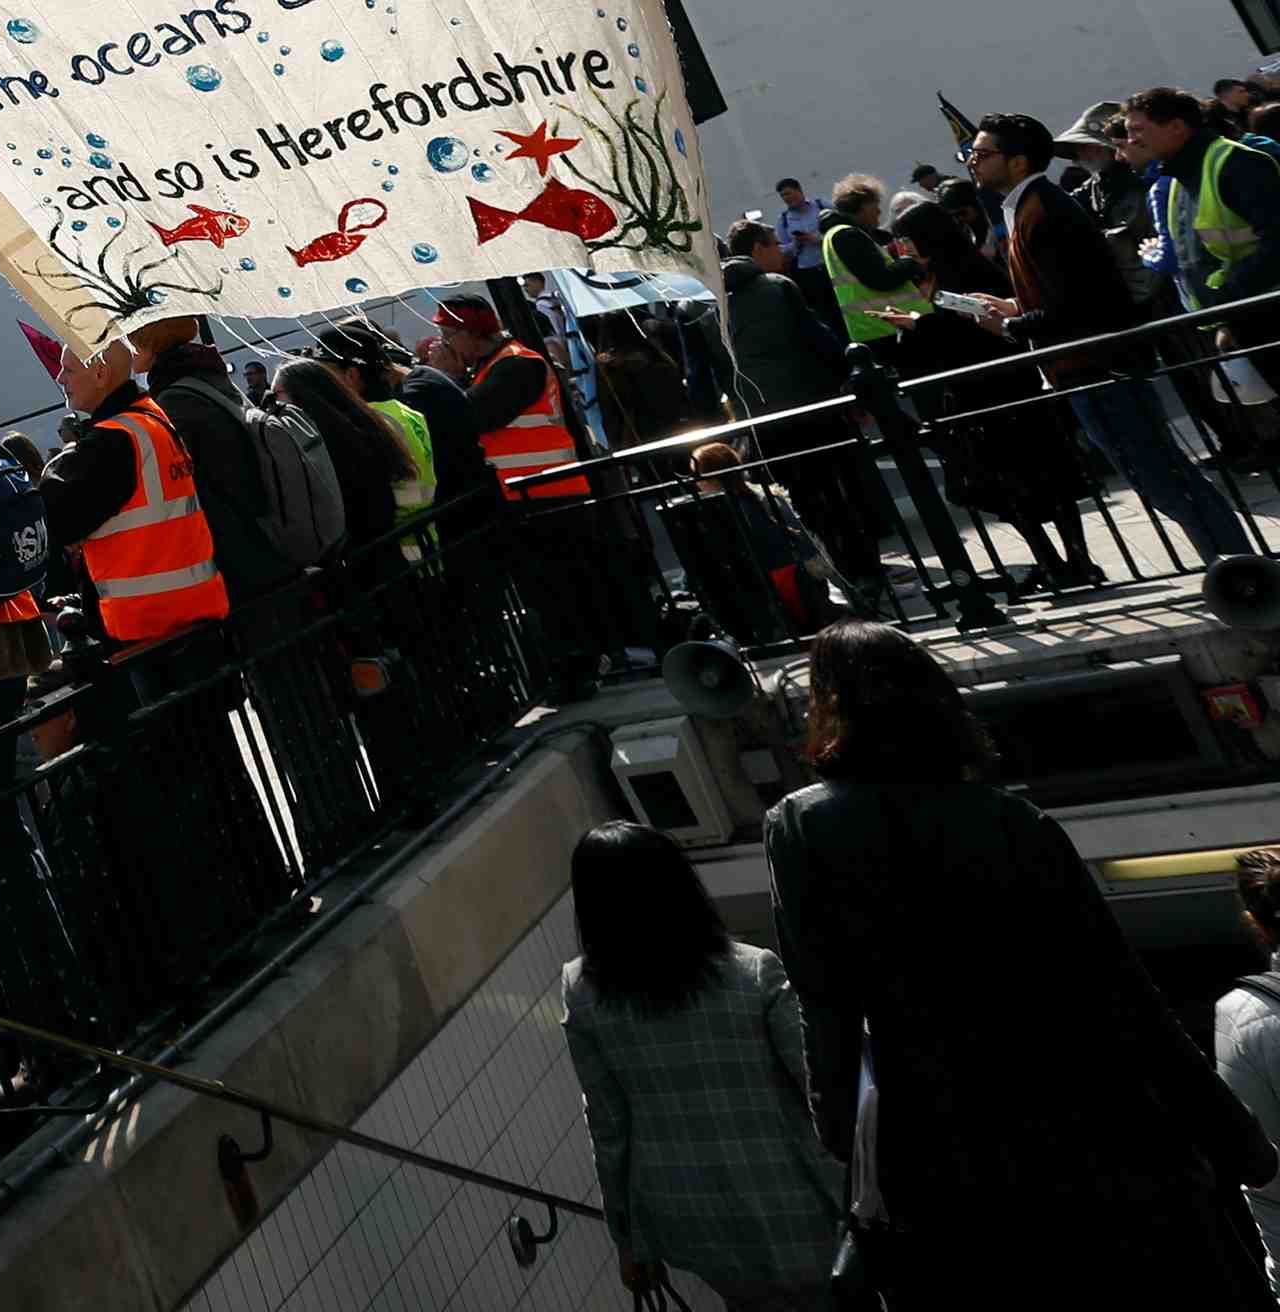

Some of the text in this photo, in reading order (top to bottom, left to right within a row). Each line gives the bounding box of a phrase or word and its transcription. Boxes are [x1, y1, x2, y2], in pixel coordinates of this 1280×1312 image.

[56, 46, 615, 211] and so is Herefordshire
